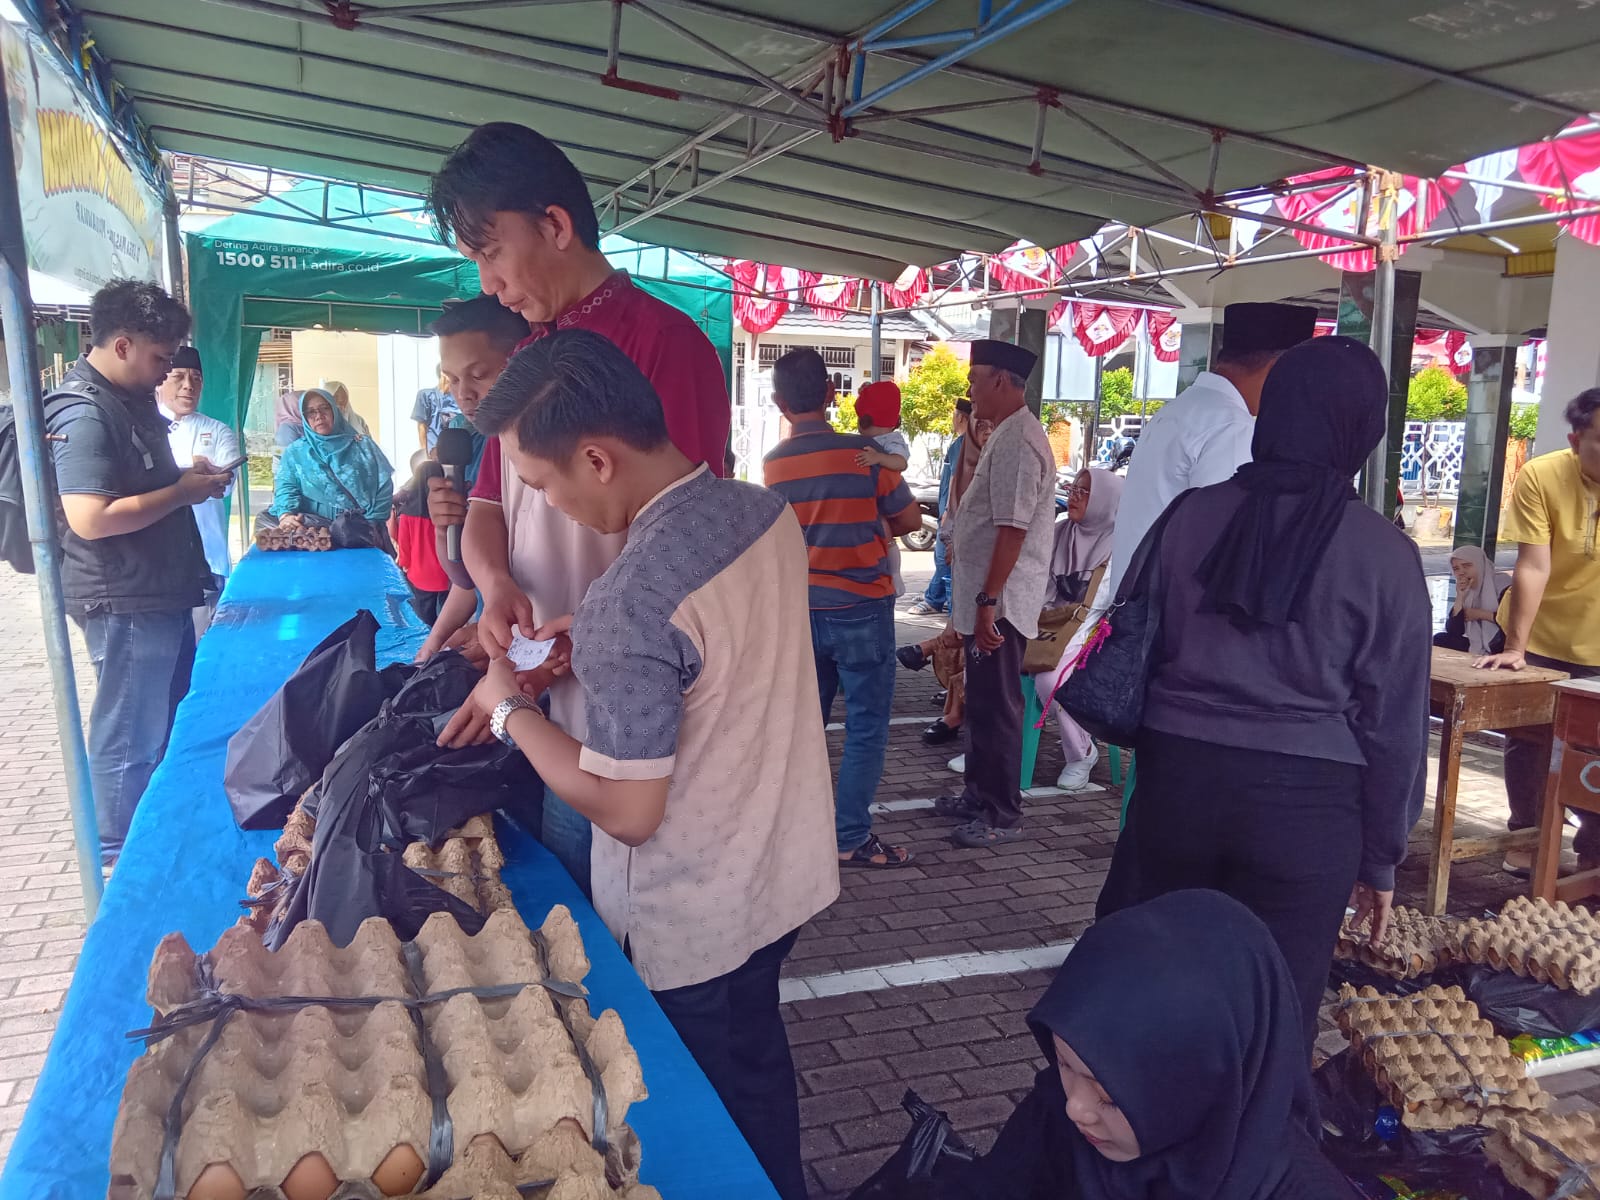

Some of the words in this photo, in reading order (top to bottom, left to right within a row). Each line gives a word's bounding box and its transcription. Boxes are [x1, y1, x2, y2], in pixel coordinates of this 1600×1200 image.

[214, 239, 249, 251] Dering
[251, 242, 279, 252] Adira
[216, 251, 265, 268] 1500
[270, 255, 297, 269] 511
[311, 260, 379, 272] adira.co.id
